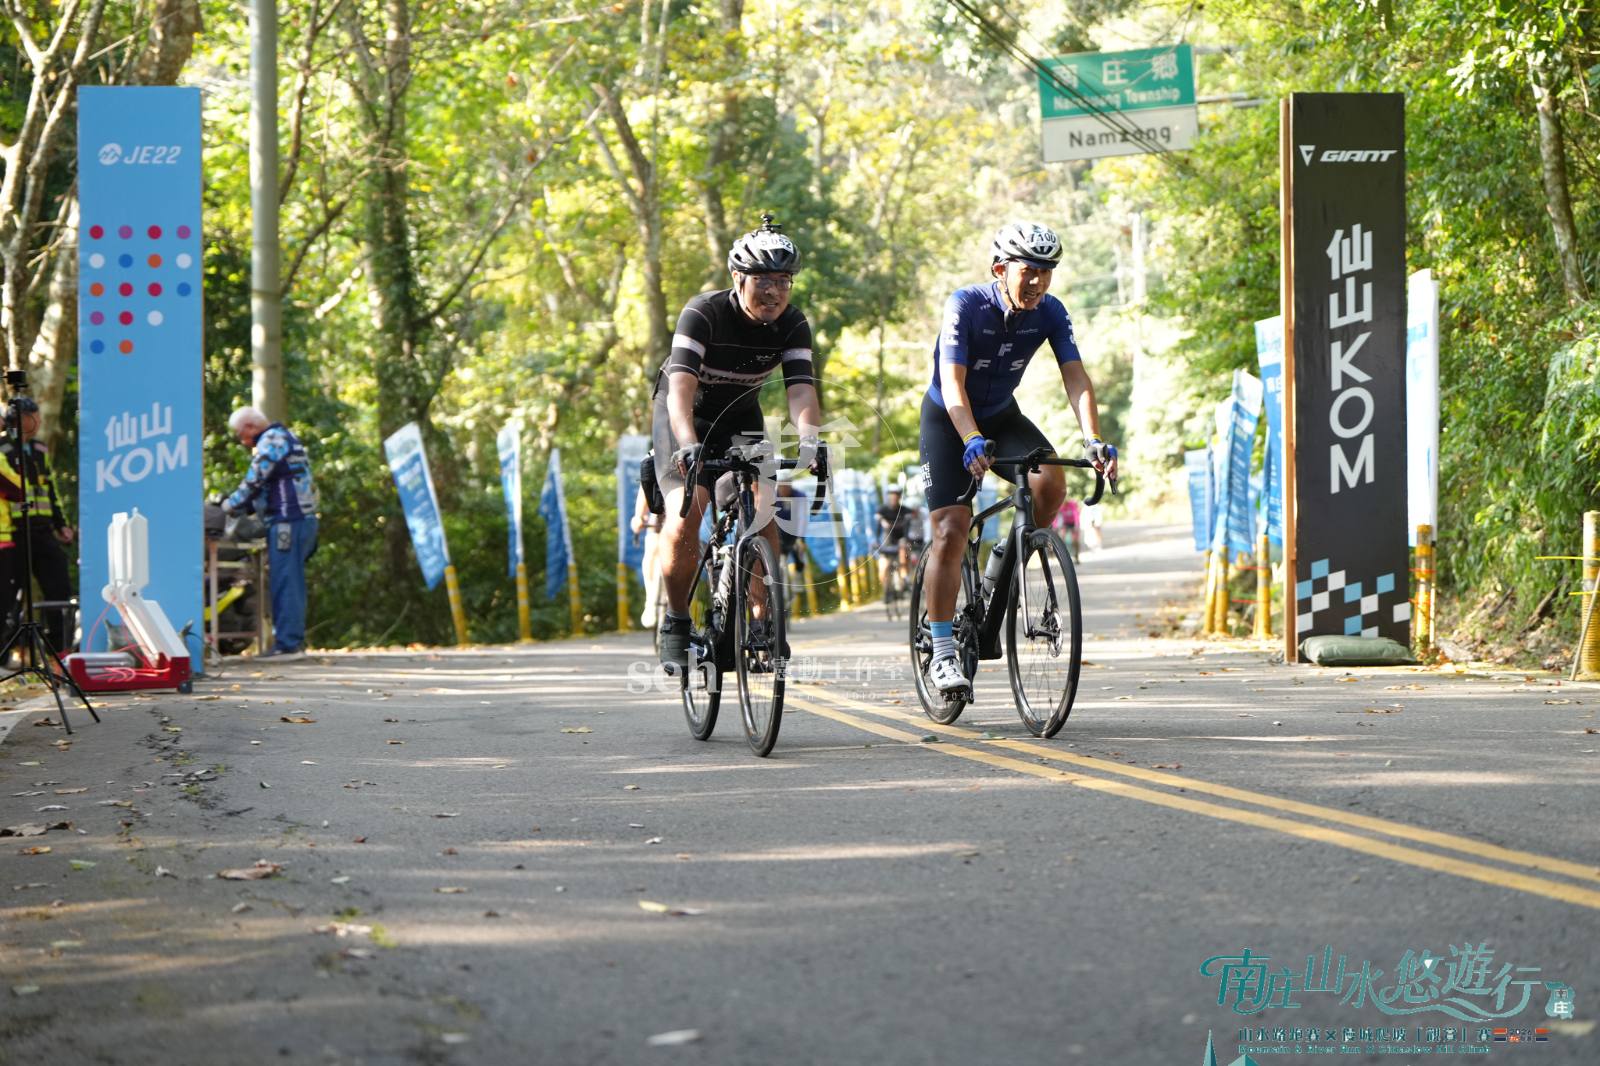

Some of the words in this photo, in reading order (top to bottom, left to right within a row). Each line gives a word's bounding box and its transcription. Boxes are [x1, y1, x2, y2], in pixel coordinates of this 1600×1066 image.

[1123, 86, 1180, 105] Township
[123, 145, 182, 165] JE22
[1319, 149, 1398, 163] GIANT
[103, 401, 172, 452] 仙山
[95, 433, 188, 493] KOM
